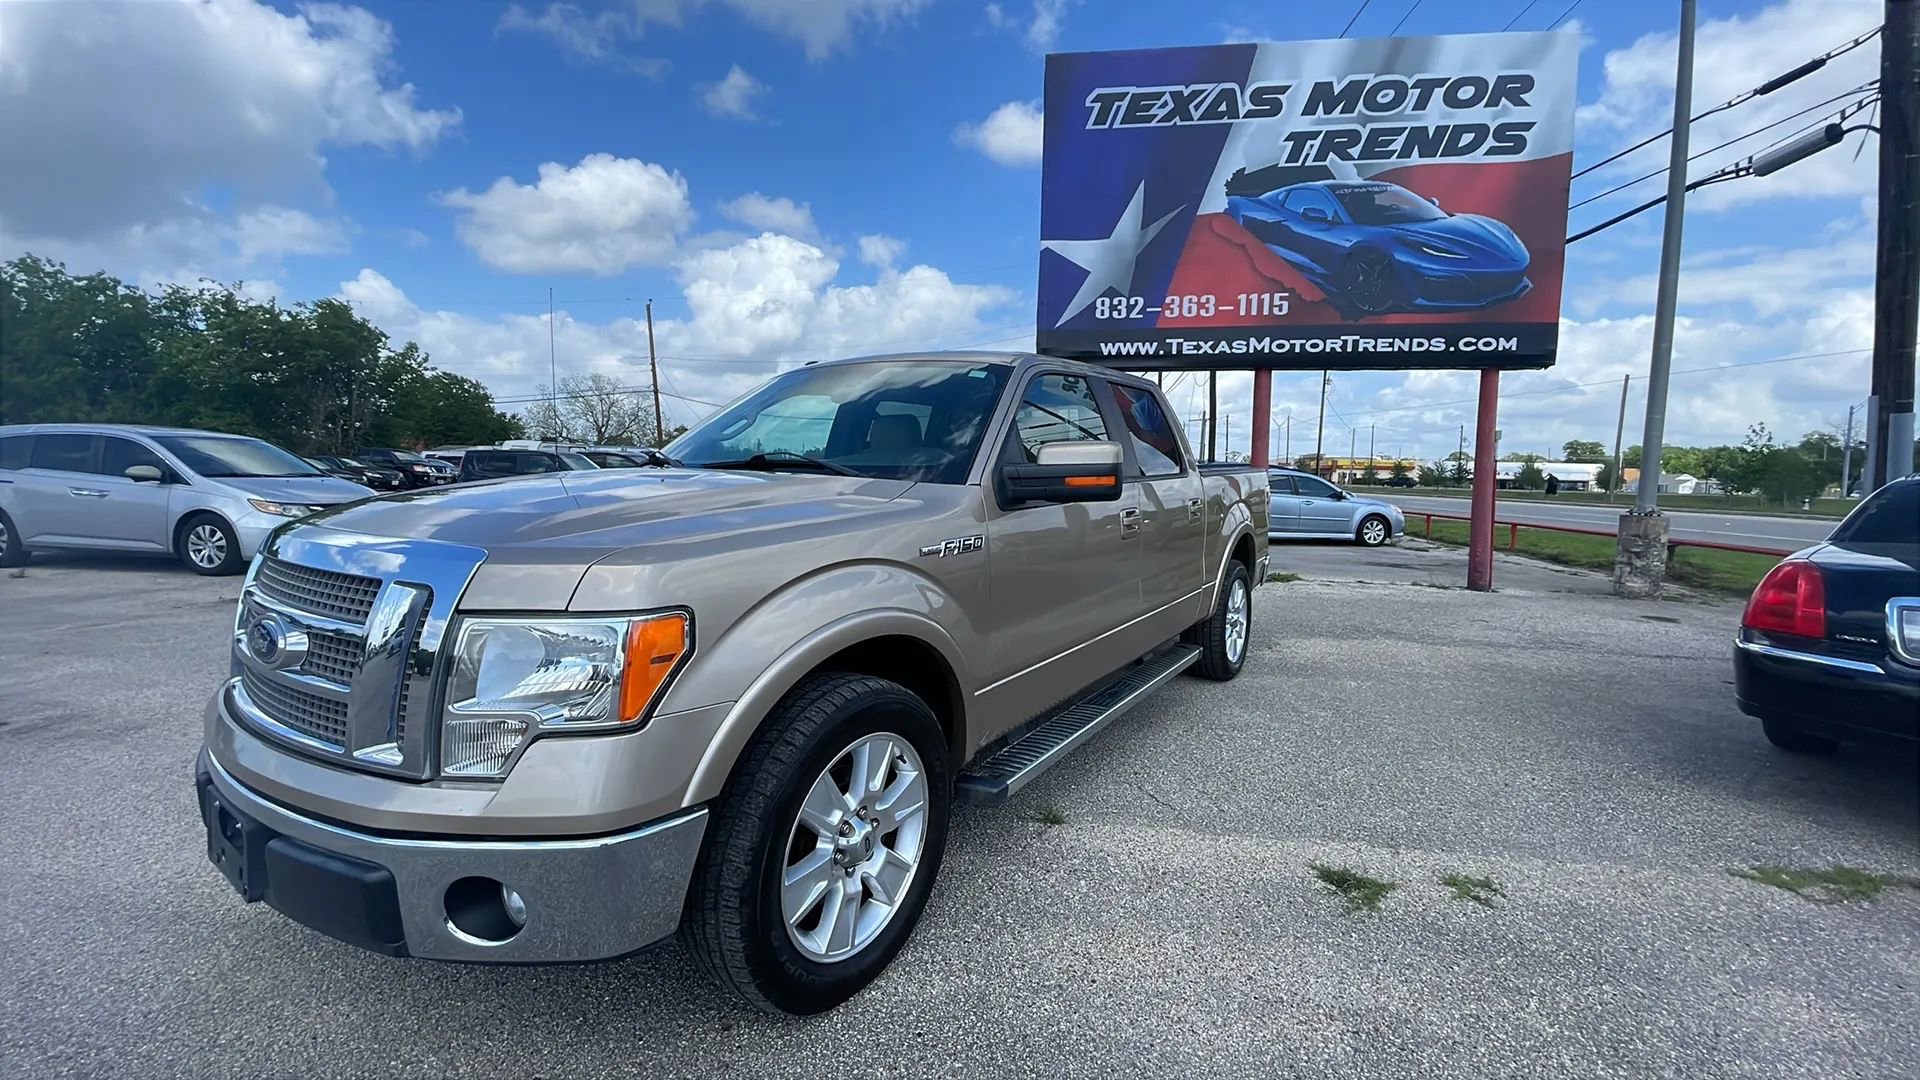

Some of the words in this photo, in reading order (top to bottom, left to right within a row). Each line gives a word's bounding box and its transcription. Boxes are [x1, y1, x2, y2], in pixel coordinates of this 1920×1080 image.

[1087, 84, 1293, 129] TEXAS
[1299, 73, 1536, 117] MOTOR
[1280, 120, 1537, 165] TRENDS
[1095, 292, 1290, 320] 832-363-1115
